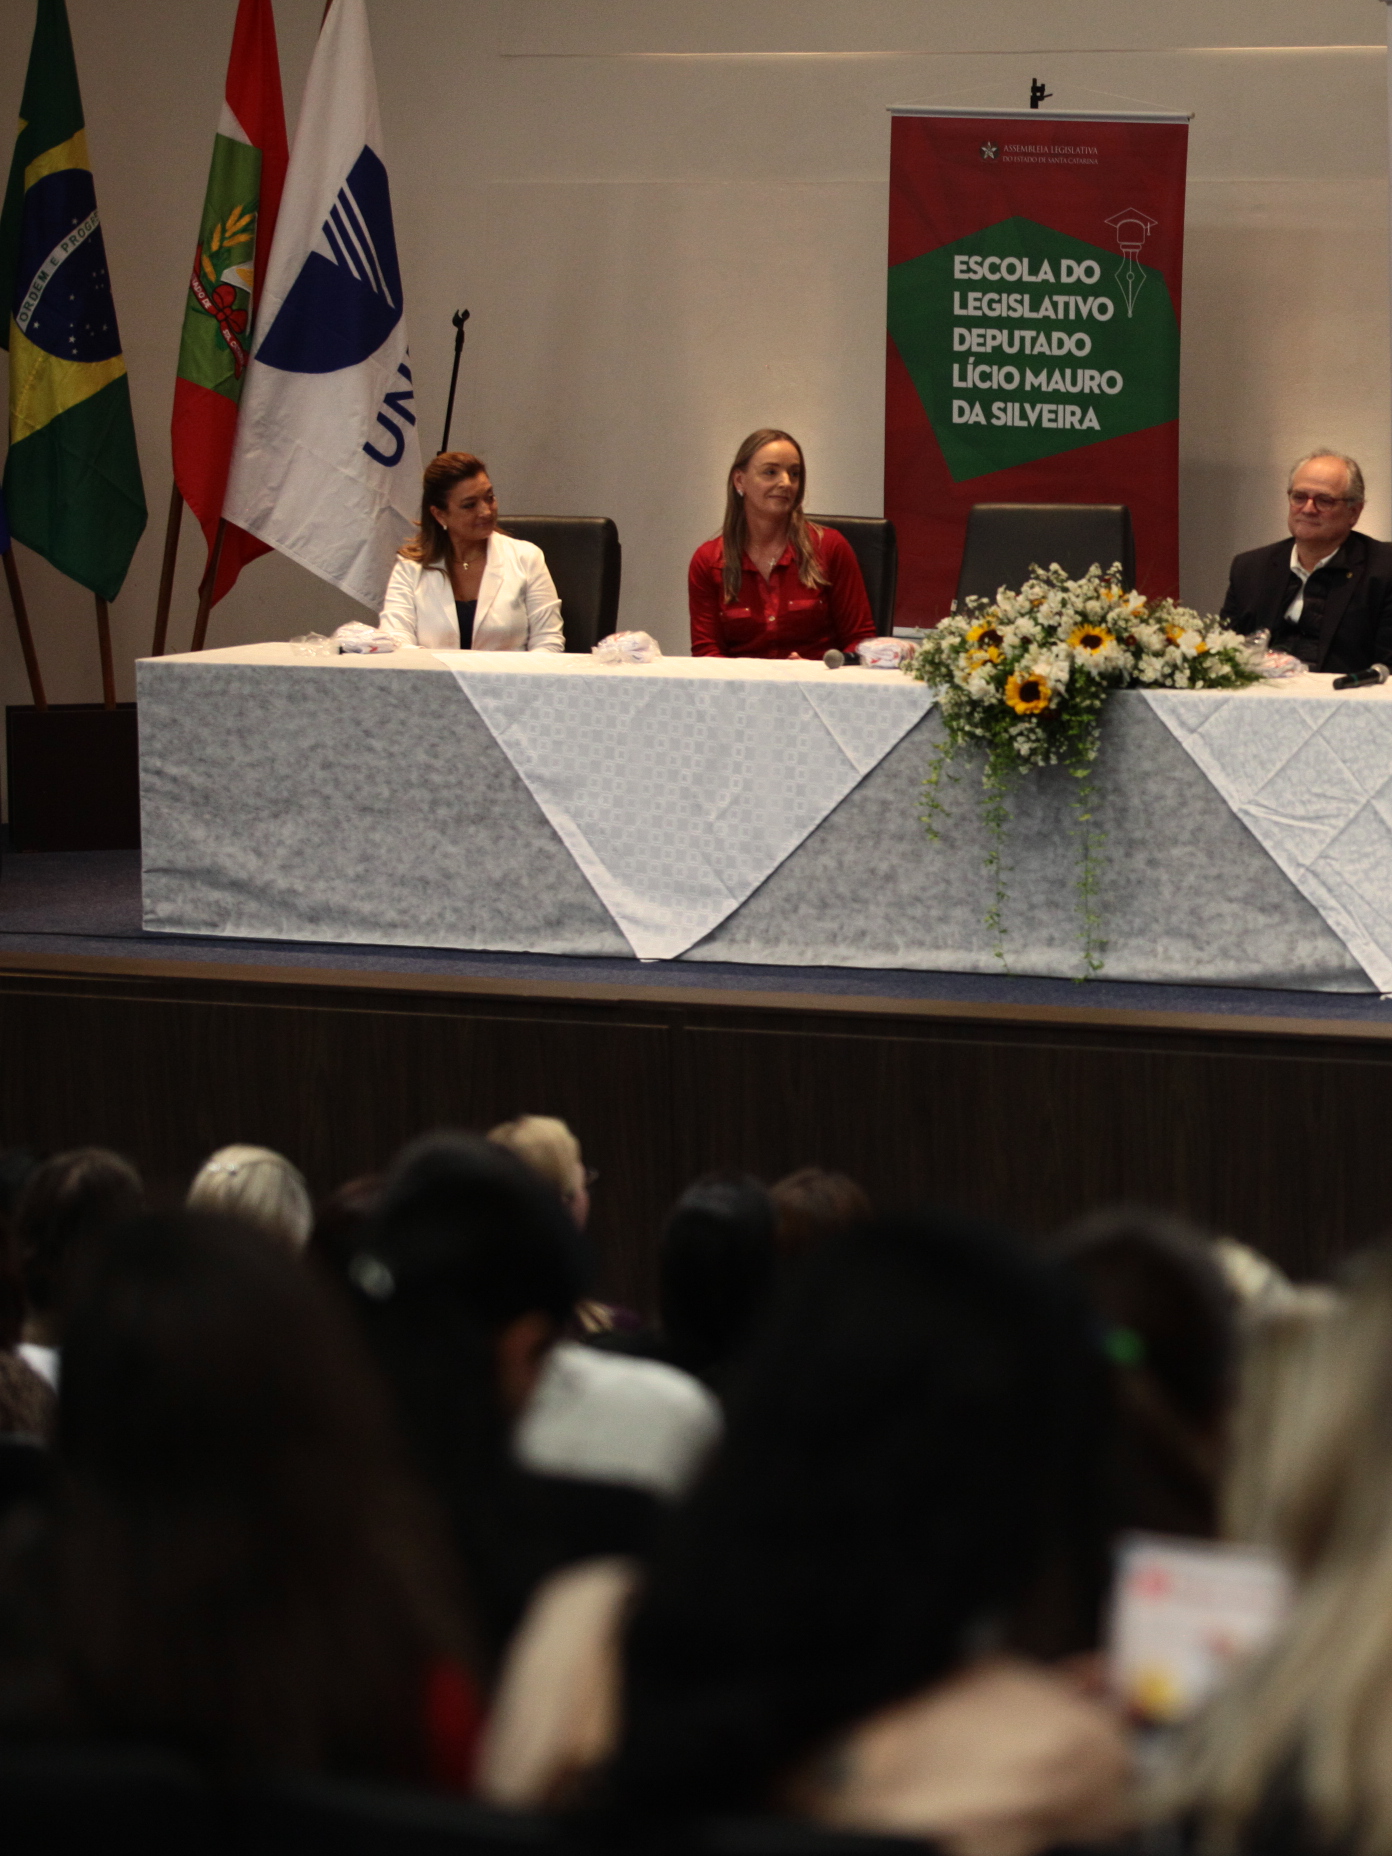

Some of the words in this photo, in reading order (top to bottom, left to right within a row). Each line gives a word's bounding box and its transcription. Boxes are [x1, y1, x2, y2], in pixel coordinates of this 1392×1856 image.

[1003, 145, 1049, 153] ASSEMBLEIA
[1051, 145, 1098, 155] LEGISLATIVA
[954, 255, 1055, 282] ESCOLA
[1060, 259, 1101, 284] DO
[20, 270, 50, 322] ORDEM
[50, 256, 59, 267] E
[953, 291, 1115, 321] LEGISLATIVO
[953, 327, 1092, 357] DEPUTADO
[952, 356, 1020, 391] LÍCIO
[1025, 367, 1124, 395] MAURO
[952, 399, 987, 426] DA
[991, 402, 1101, 430] SILVEIRA
